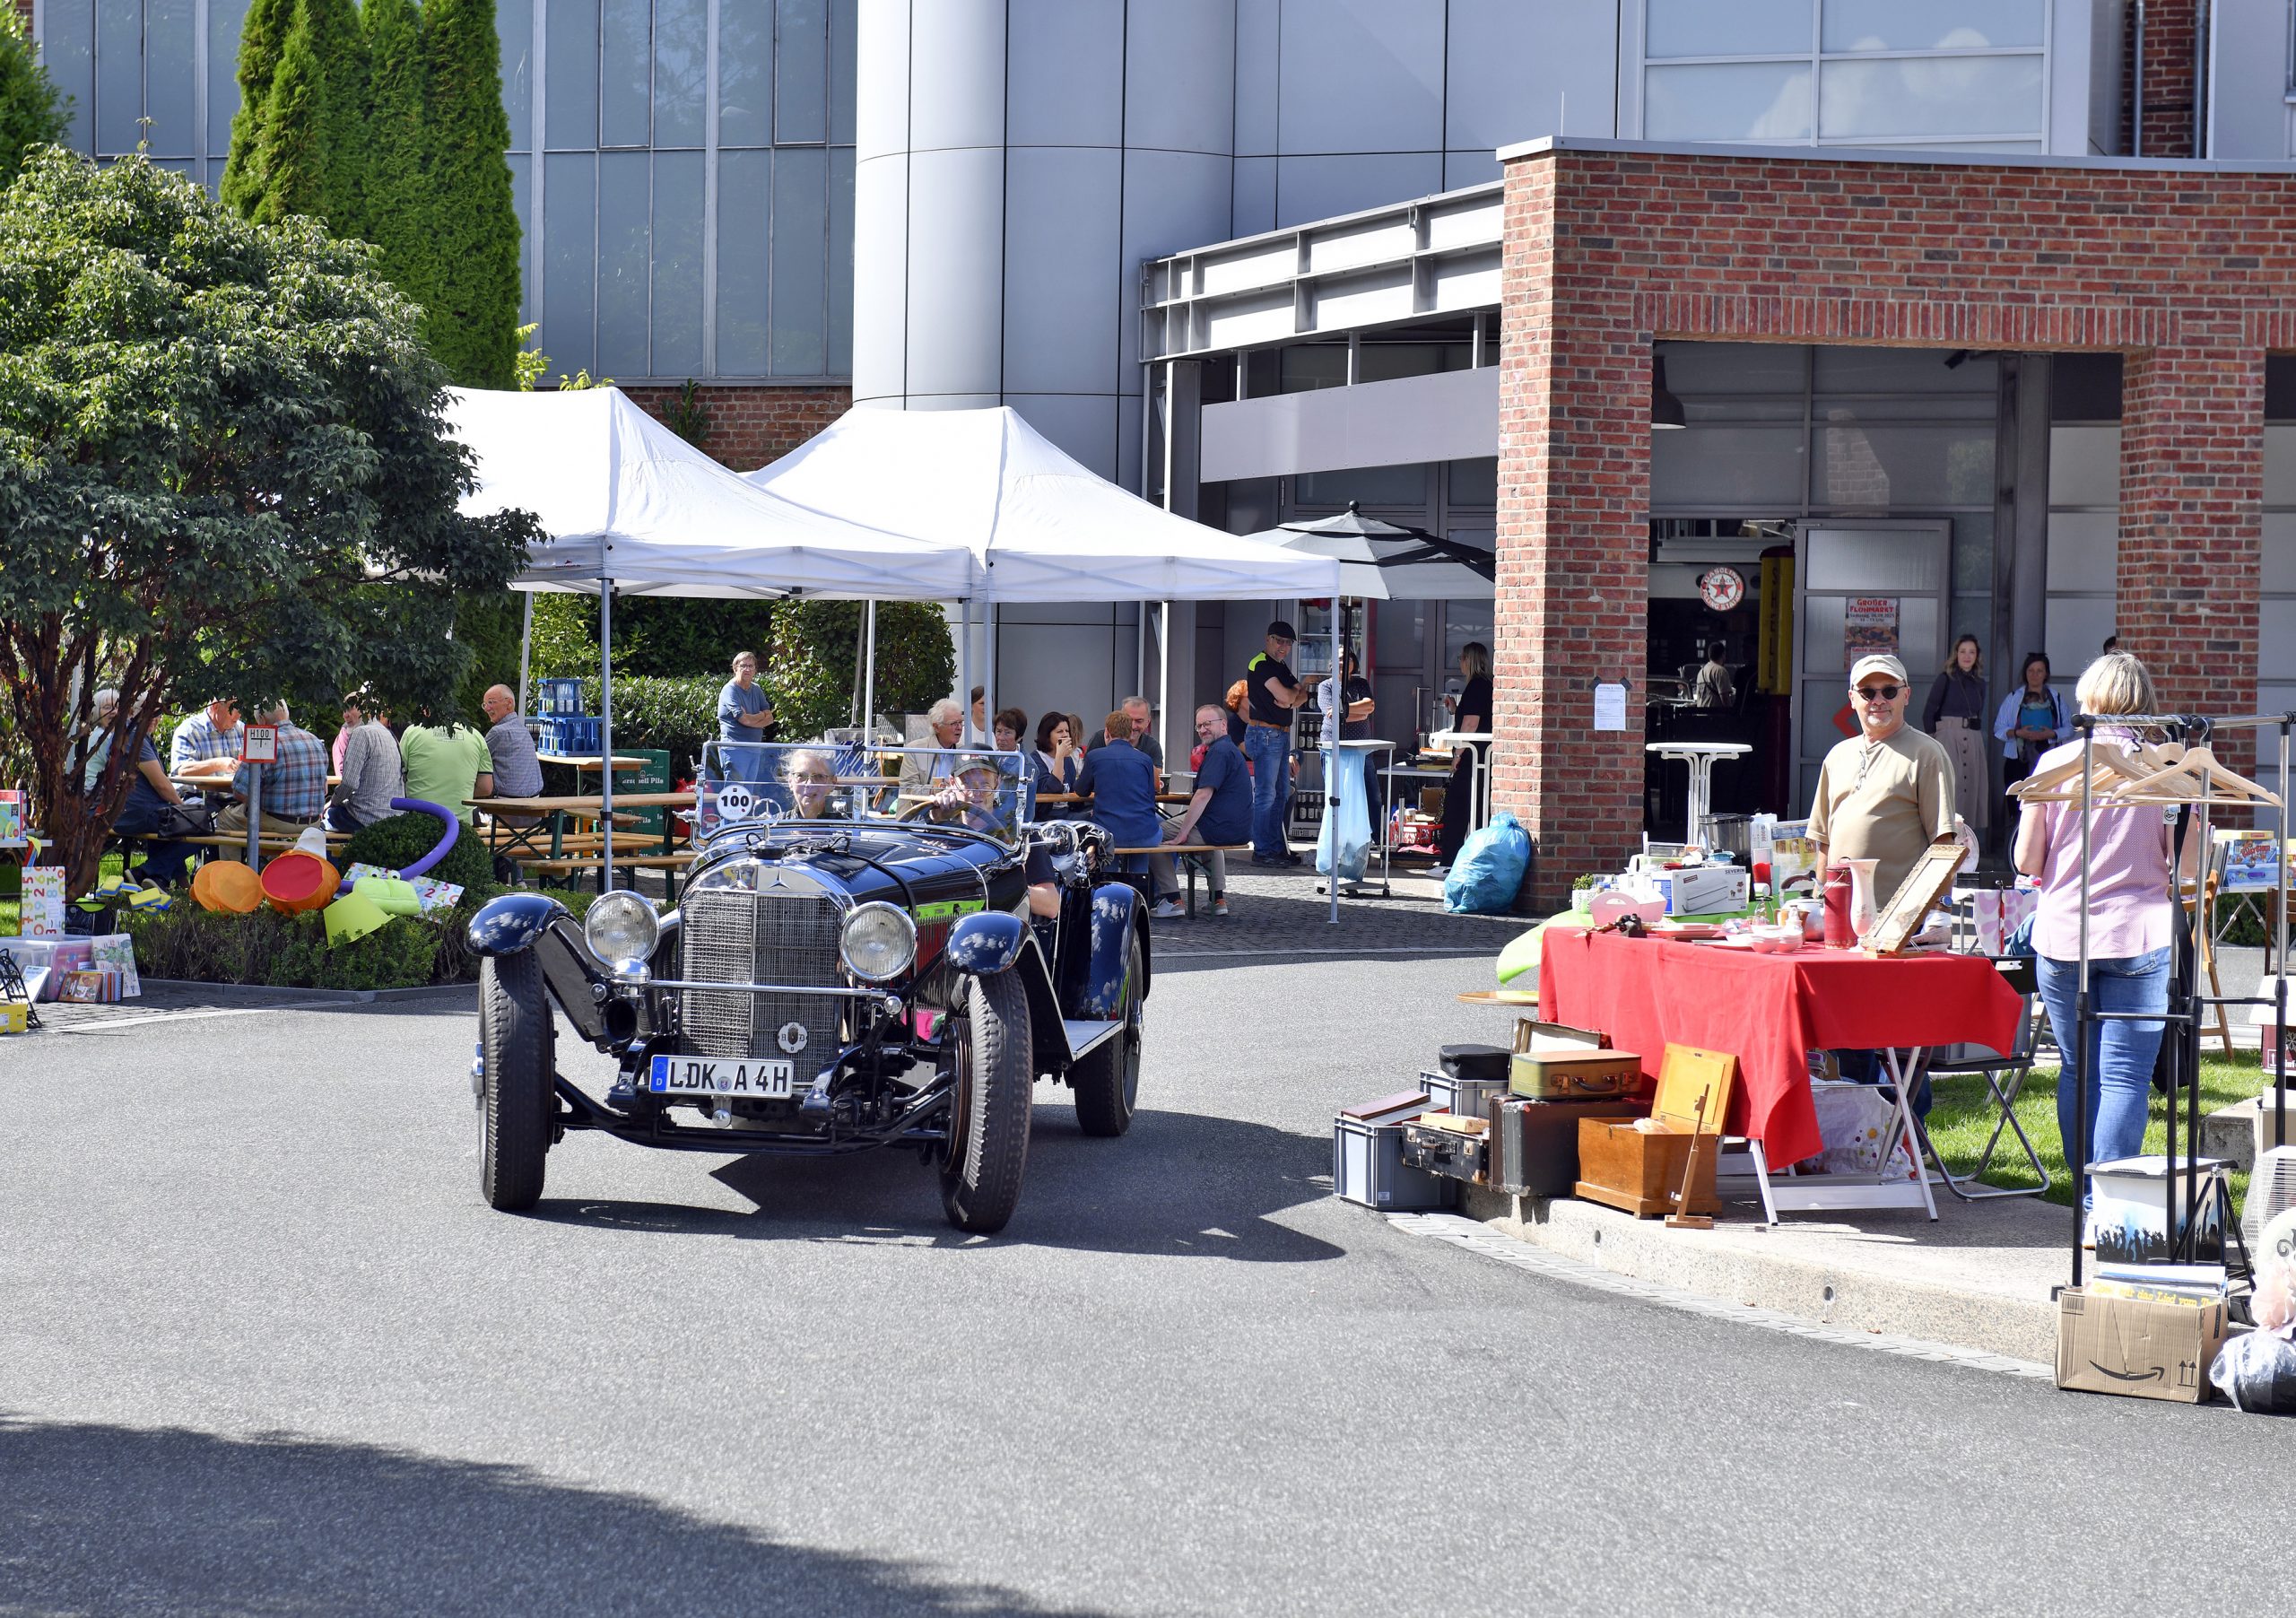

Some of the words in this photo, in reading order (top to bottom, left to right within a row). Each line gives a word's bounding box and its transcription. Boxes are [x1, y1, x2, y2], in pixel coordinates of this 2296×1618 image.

[1704, 567, 1742, 583] GASOLINE
[250, 729, 269, 737] H100
[721, 795, 750, 807] 100
[657, 1078, 663, 1086] D
[669, 1062, 717, 1089] LDK
[734, 1065, 747, 1091] A
[2137, 1290, 2153, 1301] das
[2156, 1292, 2177, 1304] Lied
[2179, 1297, 2197, 1306] vom
